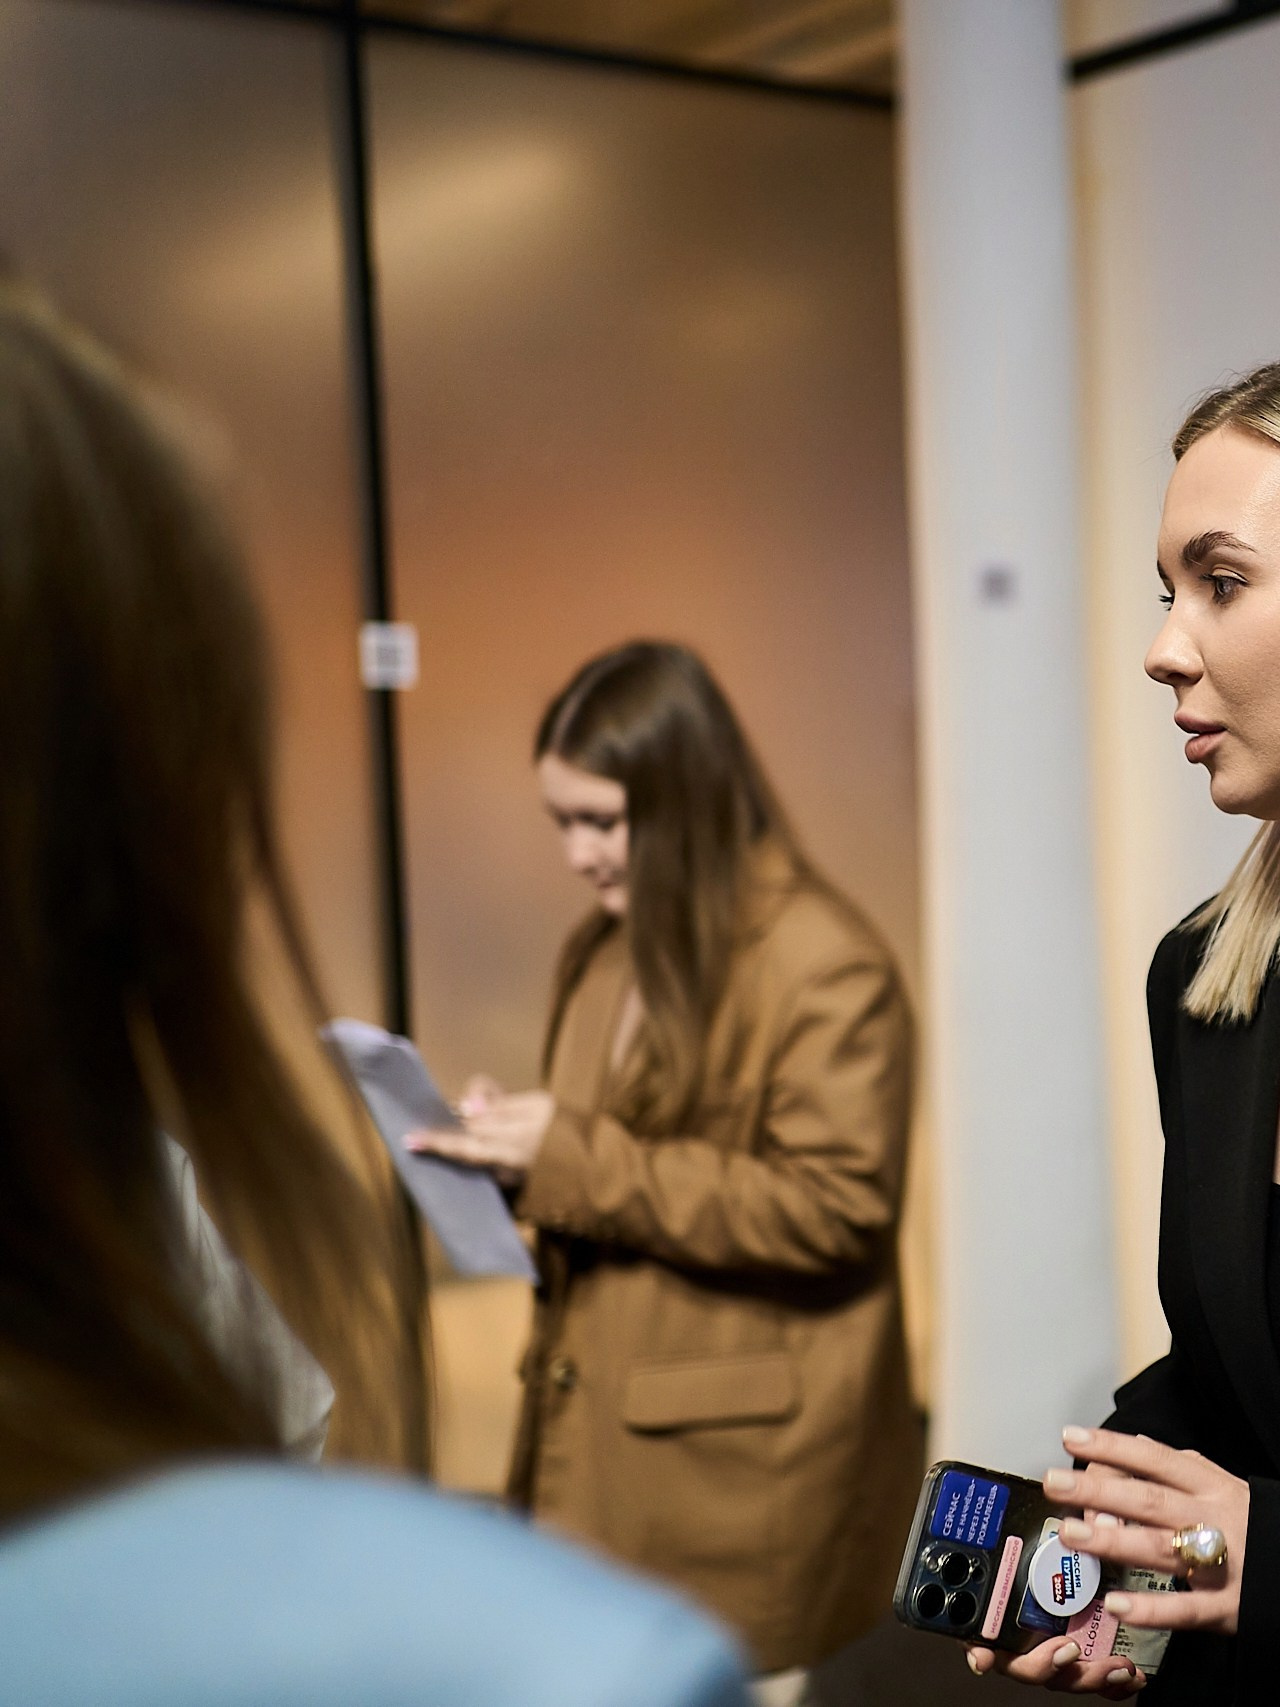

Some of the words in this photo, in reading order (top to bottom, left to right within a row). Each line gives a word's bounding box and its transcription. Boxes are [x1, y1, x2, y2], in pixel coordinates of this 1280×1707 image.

[942, 1491, 961, 1536] СЕЙЧАС
[967, 1515, 979, 1542] ЧЕРЕЗ
[974, 1496, 986, 1515] ГОД
[976, 1484, 998, 1545] ПОЖАЛЕЕШЬ
[955, 1526, 964, 1540] НЕ
[1063, 1560, 1072, 1595] ПУТИН
[1073, 1550, 1081, 1588] ОССИЯ
[1054, 1576, 1063, 1602] 2024
